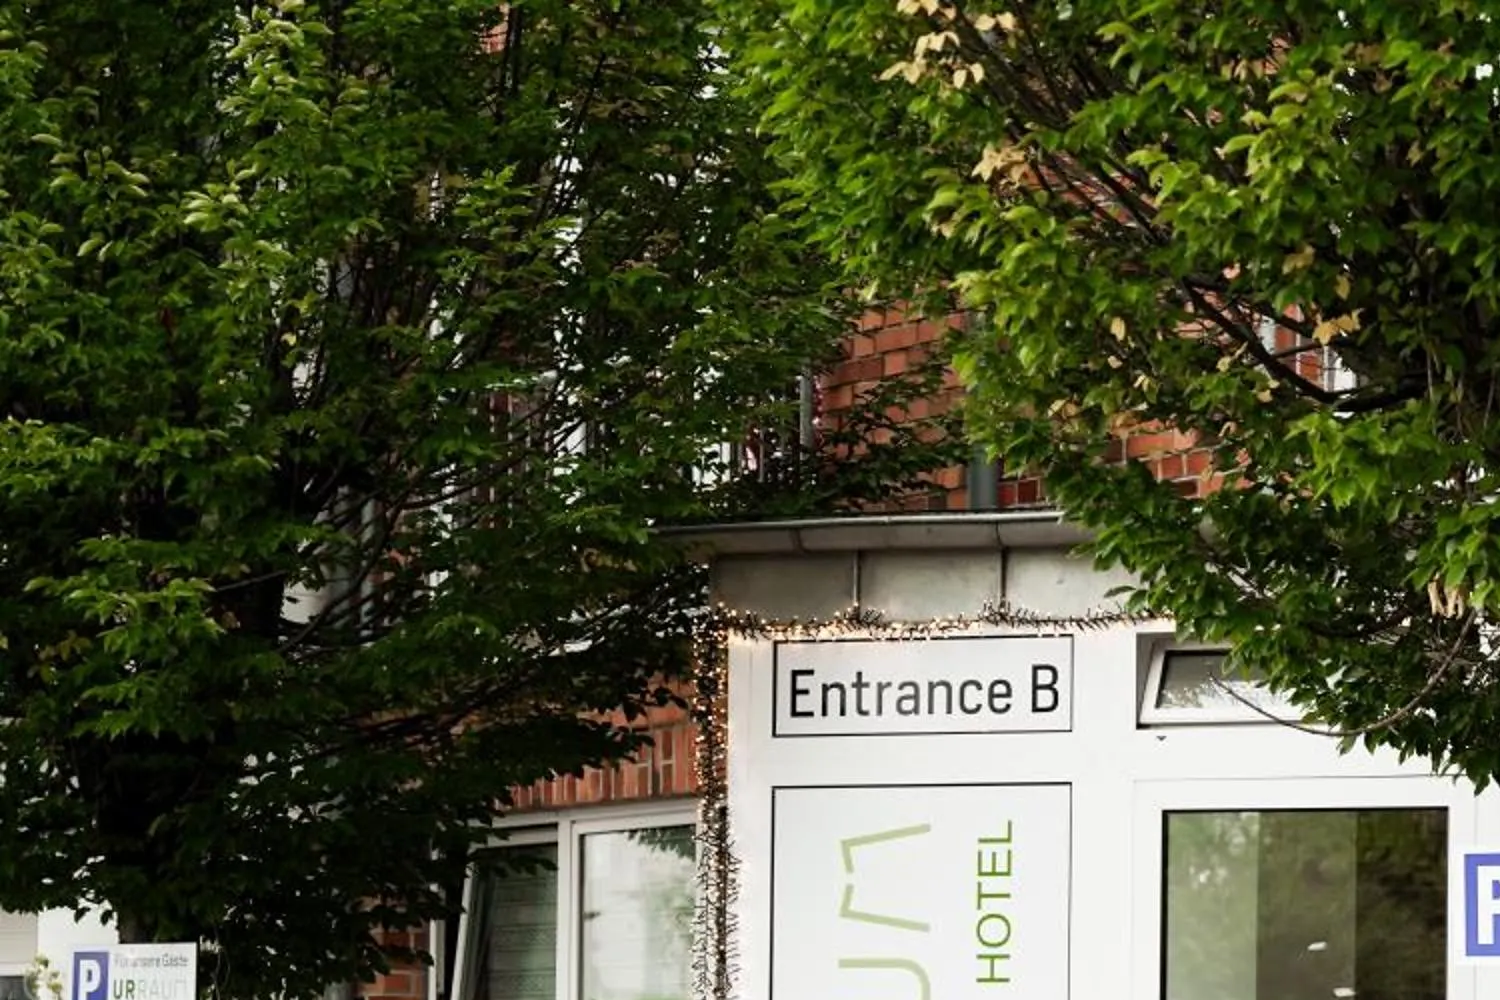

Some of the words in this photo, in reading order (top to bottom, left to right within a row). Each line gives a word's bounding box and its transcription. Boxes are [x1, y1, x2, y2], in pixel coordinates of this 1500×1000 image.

[788, 666, 1014, 719] Entrance
[1031, 664, 1060, 713] B
[976, 819, 1014, 984] HOTEL
